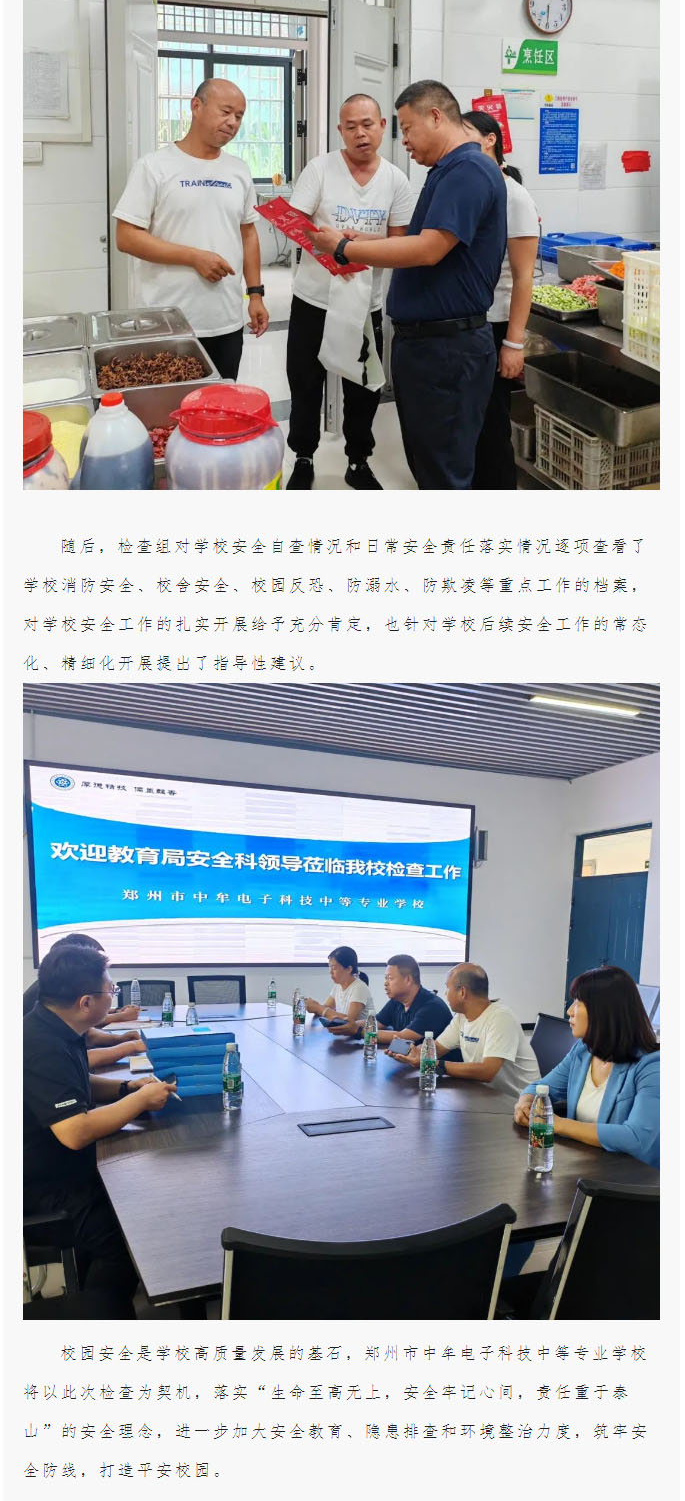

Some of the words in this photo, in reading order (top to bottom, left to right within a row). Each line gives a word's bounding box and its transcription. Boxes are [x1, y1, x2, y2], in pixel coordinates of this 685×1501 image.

[61, 538, 643, 554] 随后，检查组对学校安全自查情况和日常安全责任落实情况逐项查看了
[24, 577, 637, 593] 学校消防安全、校舍安全、校园反恐、防溺水、防欺凌等重点工作的档案，
[24, 616, 646, 632] 对学校安全工作的扎实开展给予充分肯定，也针对学校后续安全工作的常态
[24, 655, 317, 671] 化、精细化开展提出了指导性建议。
[50, 840, 462, 880] 欢迎教育局安全科领导莅临我校检查工作
[122, 888, 425, 910] 郑州市中牟电子科技中等专业学校
[61, 1345, 646, 1361] 校园安全是学校高质量发展的基石，郑州市中牟电子科技中等专业学校
[24, 1384, 628, 1400] 将以此次检查为契机，落实“生命至高无上，安全牢记心间，责任重于泰
[25, 1423, 647, 1439] 山”的安全理念，进一步加大安全教育、隐患排查和环境整治力度，筑牢安
[24, 1462, 223, 1478] 全防线，打造平安校园。
